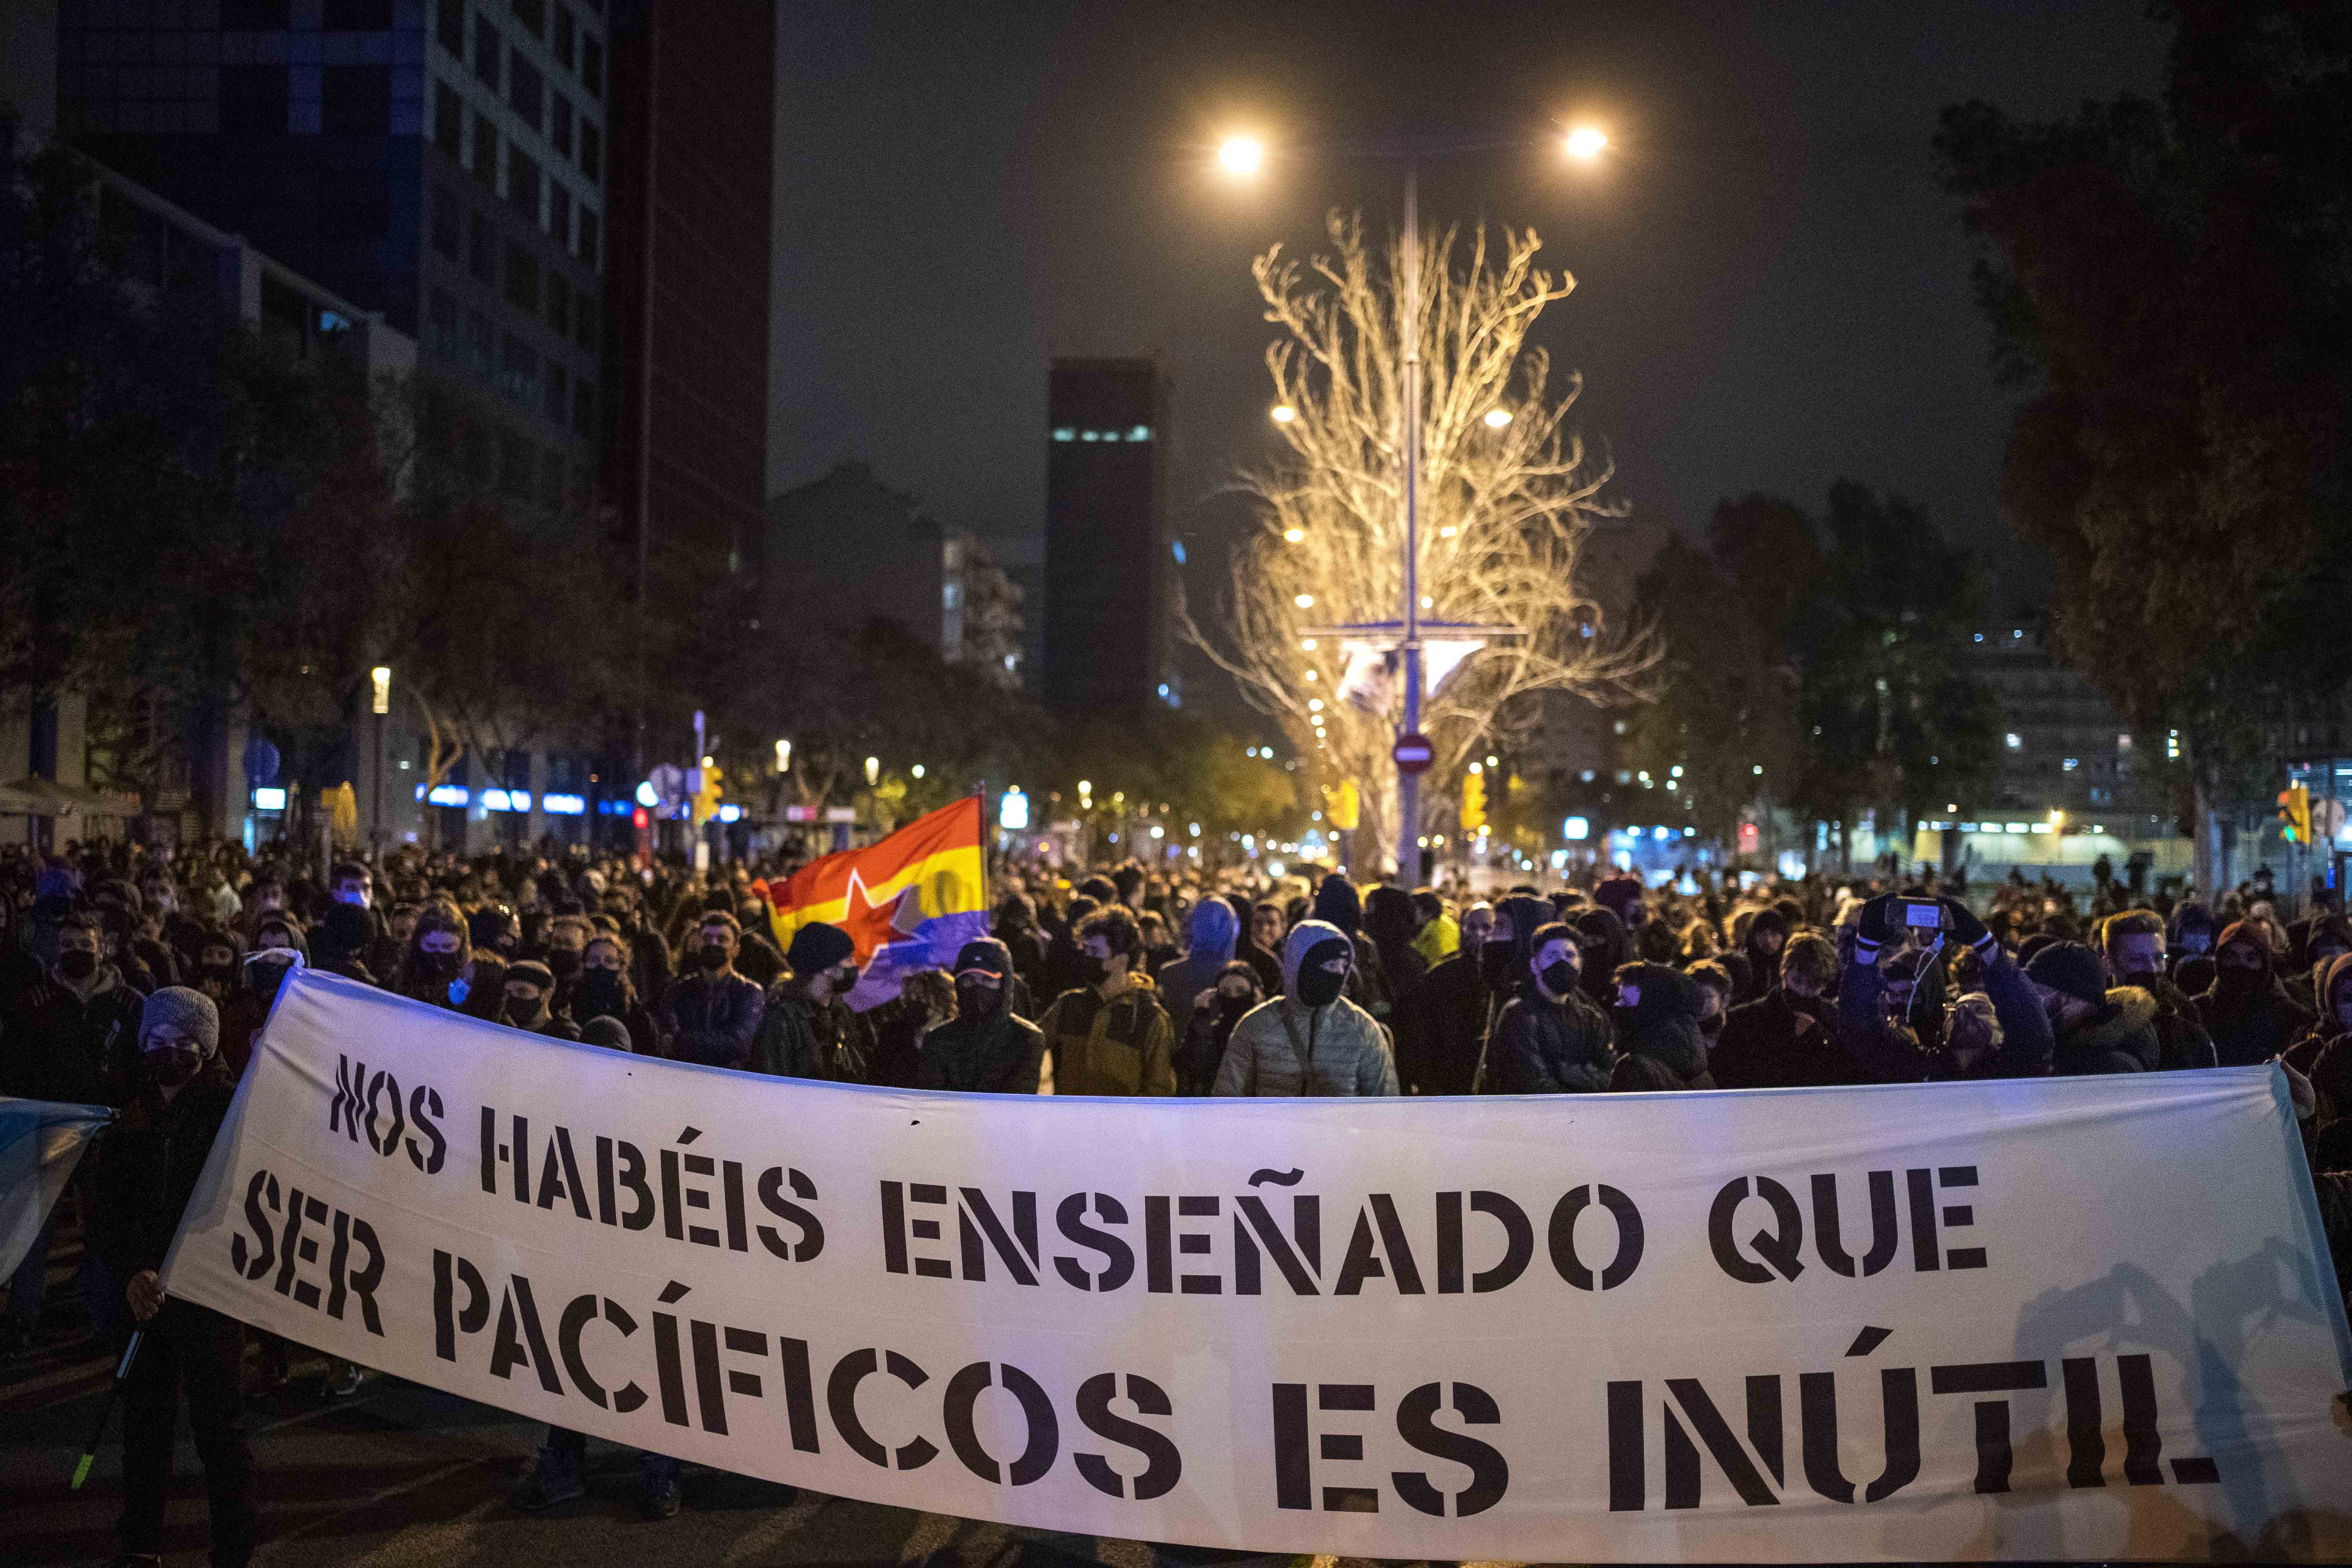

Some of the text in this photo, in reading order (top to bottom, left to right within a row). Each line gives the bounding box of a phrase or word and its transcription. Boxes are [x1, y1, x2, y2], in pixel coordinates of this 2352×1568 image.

[330, 1055, 1987, 1294] NOS HABÉIS ENSEÑADO QUE
[230, 1170, 2220, 1517] SER PACÍFICOS ES INÚTIL
